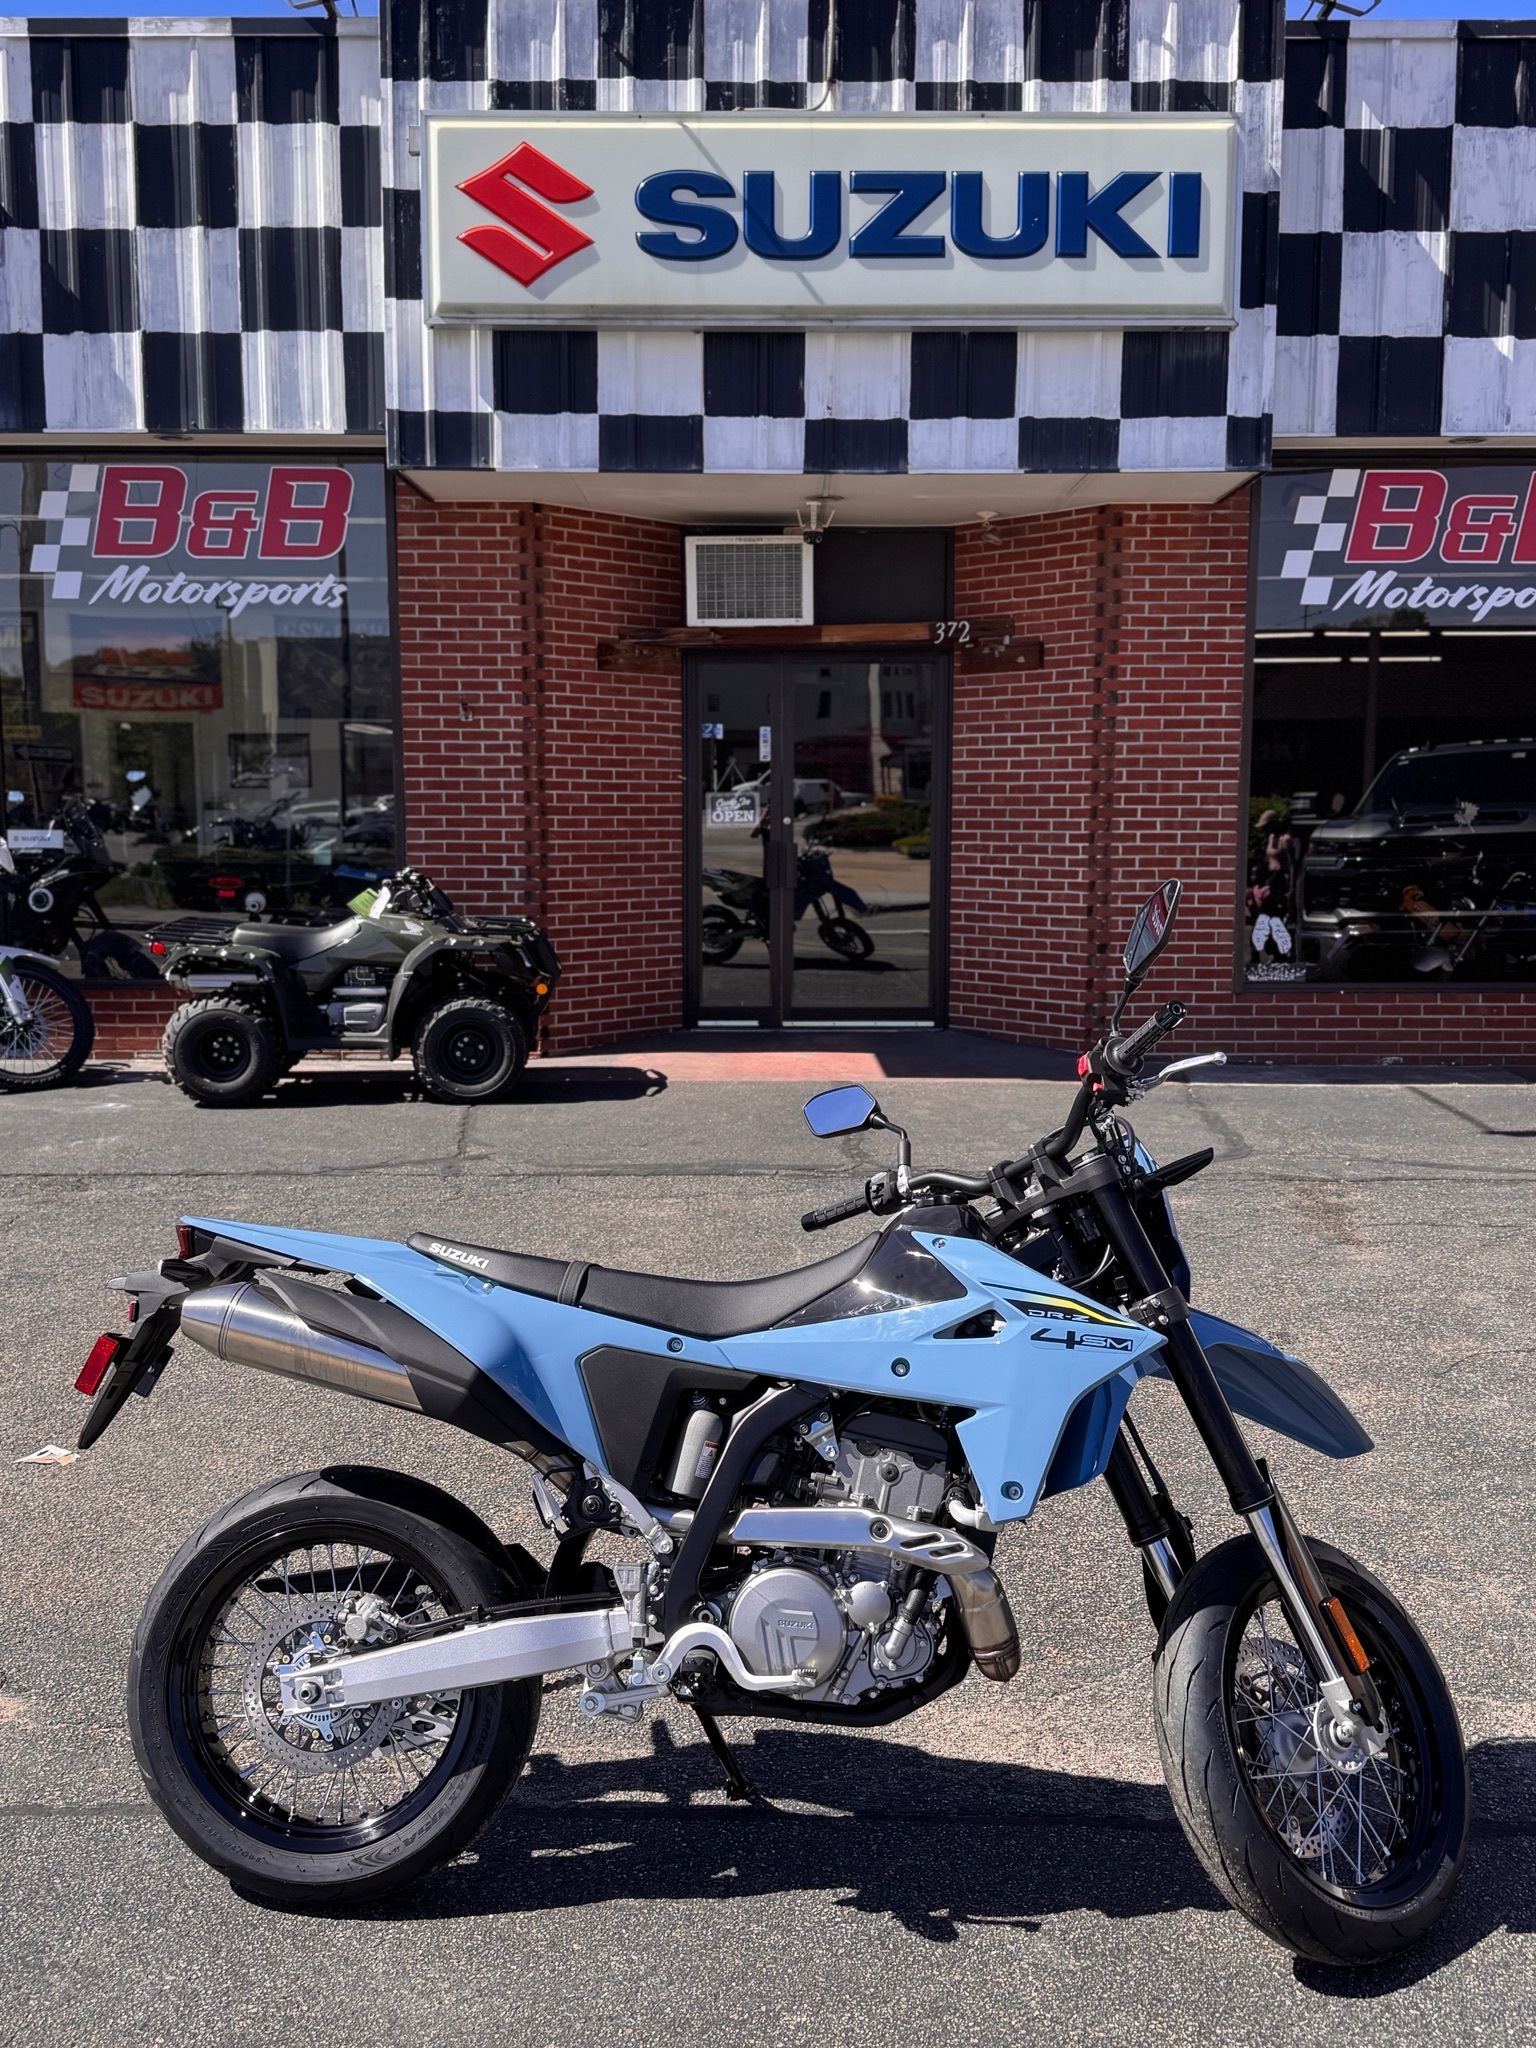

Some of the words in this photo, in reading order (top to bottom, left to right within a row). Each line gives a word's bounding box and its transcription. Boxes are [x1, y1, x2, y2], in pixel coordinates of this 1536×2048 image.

[634, 169, 1202, 260] SUZUKI
[92, 464, 354, 560] B&B
[1344, 469, 1536, 563] B&
[88, 564, 348, 619] Motorsports
[1331, 570, 1536, 622] Motorspo
[934, 620, 970, 644] 372
[80, 685, 214, 709] SUZUKI
[712, 810, 755, 822] OPEN
[428, 1242, 490, 1269] SUZUKI
[1027, 1308, 1090, 1323] DR-Z
[777, 1619, 814, 1631] SUZUKI
